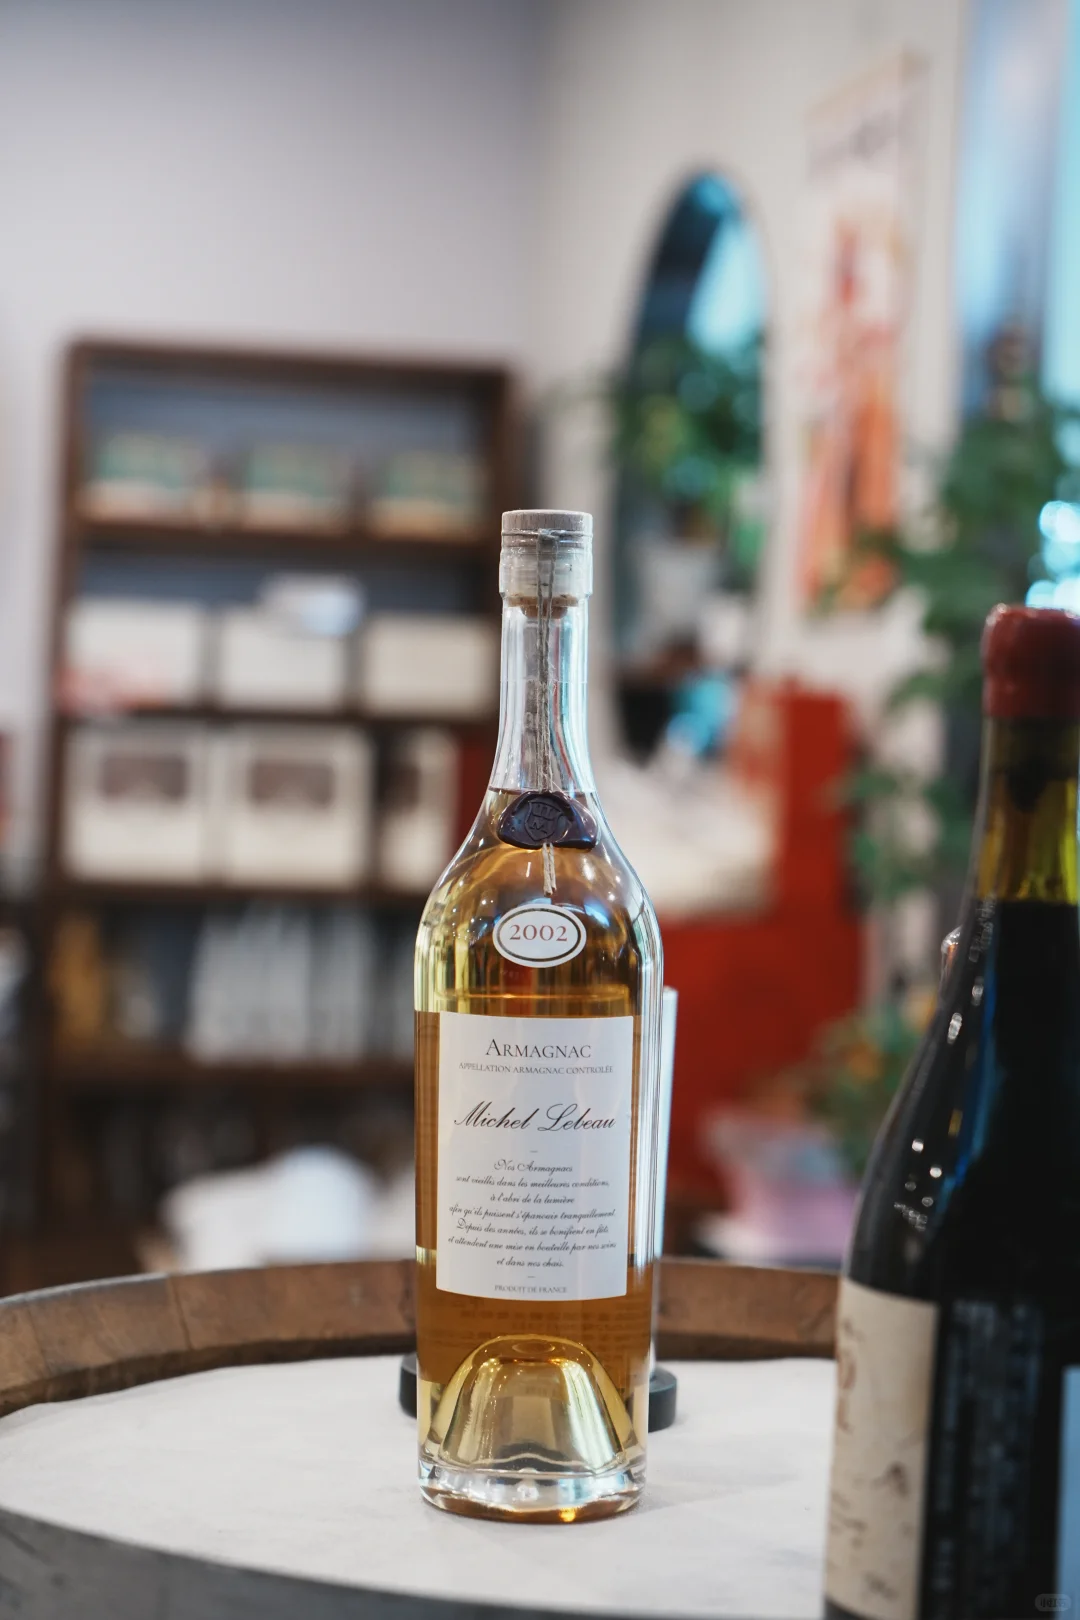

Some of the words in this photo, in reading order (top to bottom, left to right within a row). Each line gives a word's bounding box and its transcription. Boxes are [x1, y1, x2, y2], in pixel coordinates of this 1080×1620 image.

[509, 923, 568, 942] 2002
[458, 1062, 511, 1073] APPELLATION
[513, 1066, 565, 1075] ARMAGNAC
[454, 1100, 540, 1130] Michel
[537, 1103, 617, 1132] Lebeau
[493, 1158, 515, 1171] Nos
[516, 1160, 573, 1176] Armagnacs
[455, 1175, 471, 1183] sont
[471, 1175, 495, 1186] vieillis
[496, 1176, 516, 1187] dans
[517, 1177, 528, 1188] les
[530, 1177, 570, 1188] meilleures
[489, 1193, 496, 1201] à
[497, 1192, 520, 1203] l'abri
[521, 1193, 531, 1203] de
[533, 1193, 542, 1204] la
[543, 1194, 575, 1204] lumière
[448, 1203, 462, 1216] afin
[463, 1206, 483, 1218] qu'ils
[482, 1208, 516, 1220] puissent
[515, 1210, 558, 1223] s'épanouir
[456, 1217, 483, 1233] Depuis
[483, 1222, 496, 1233] des
[497, 1226, 527, 1236] années,
[528, 1225, 539, 1236] ils
[549, 1225, 586, 1239] bonifient
[454, 1237, 488, 1248] attendent
[505, 1242, 524, 1251] mise
[536, 1241, 570, 1251] bouteille
[568, 1243, 587, 1255] par
[600, 1240, 617, 1250] soins
[496, 1257, 505, 1266] et
[505, 1256, 525, 1267] dans
[494, 1284, 526, 1294] PRODUIT
[527, 1286, 537, 1294] DE
[538, 1286, 568, 1294] FRANCE
